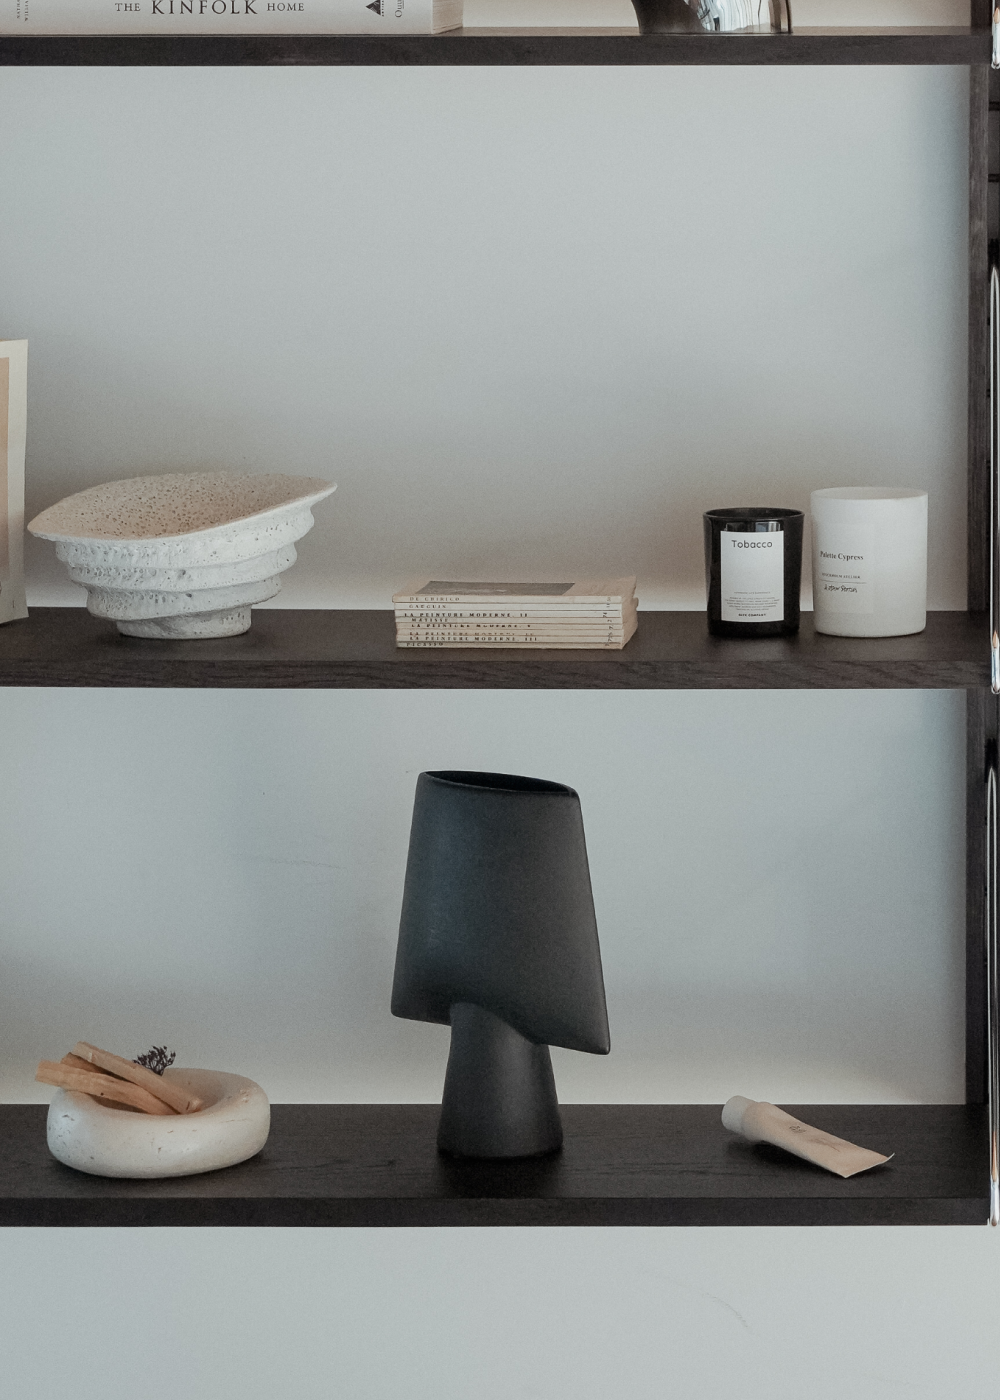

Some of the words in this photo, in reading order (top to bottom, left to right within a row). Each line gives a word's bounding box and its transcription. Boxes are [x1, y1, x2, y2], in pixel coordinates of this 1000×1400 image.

[115, 3, 141, 12] THE
[151, 0, 258, 15] KINFOLK
[267, 2, 305, 11] HOME
[731, 539, 773, 549] Tobacco
[820, 551, 836, 559] Palette
[838, 553, 863, 561] Cypress
